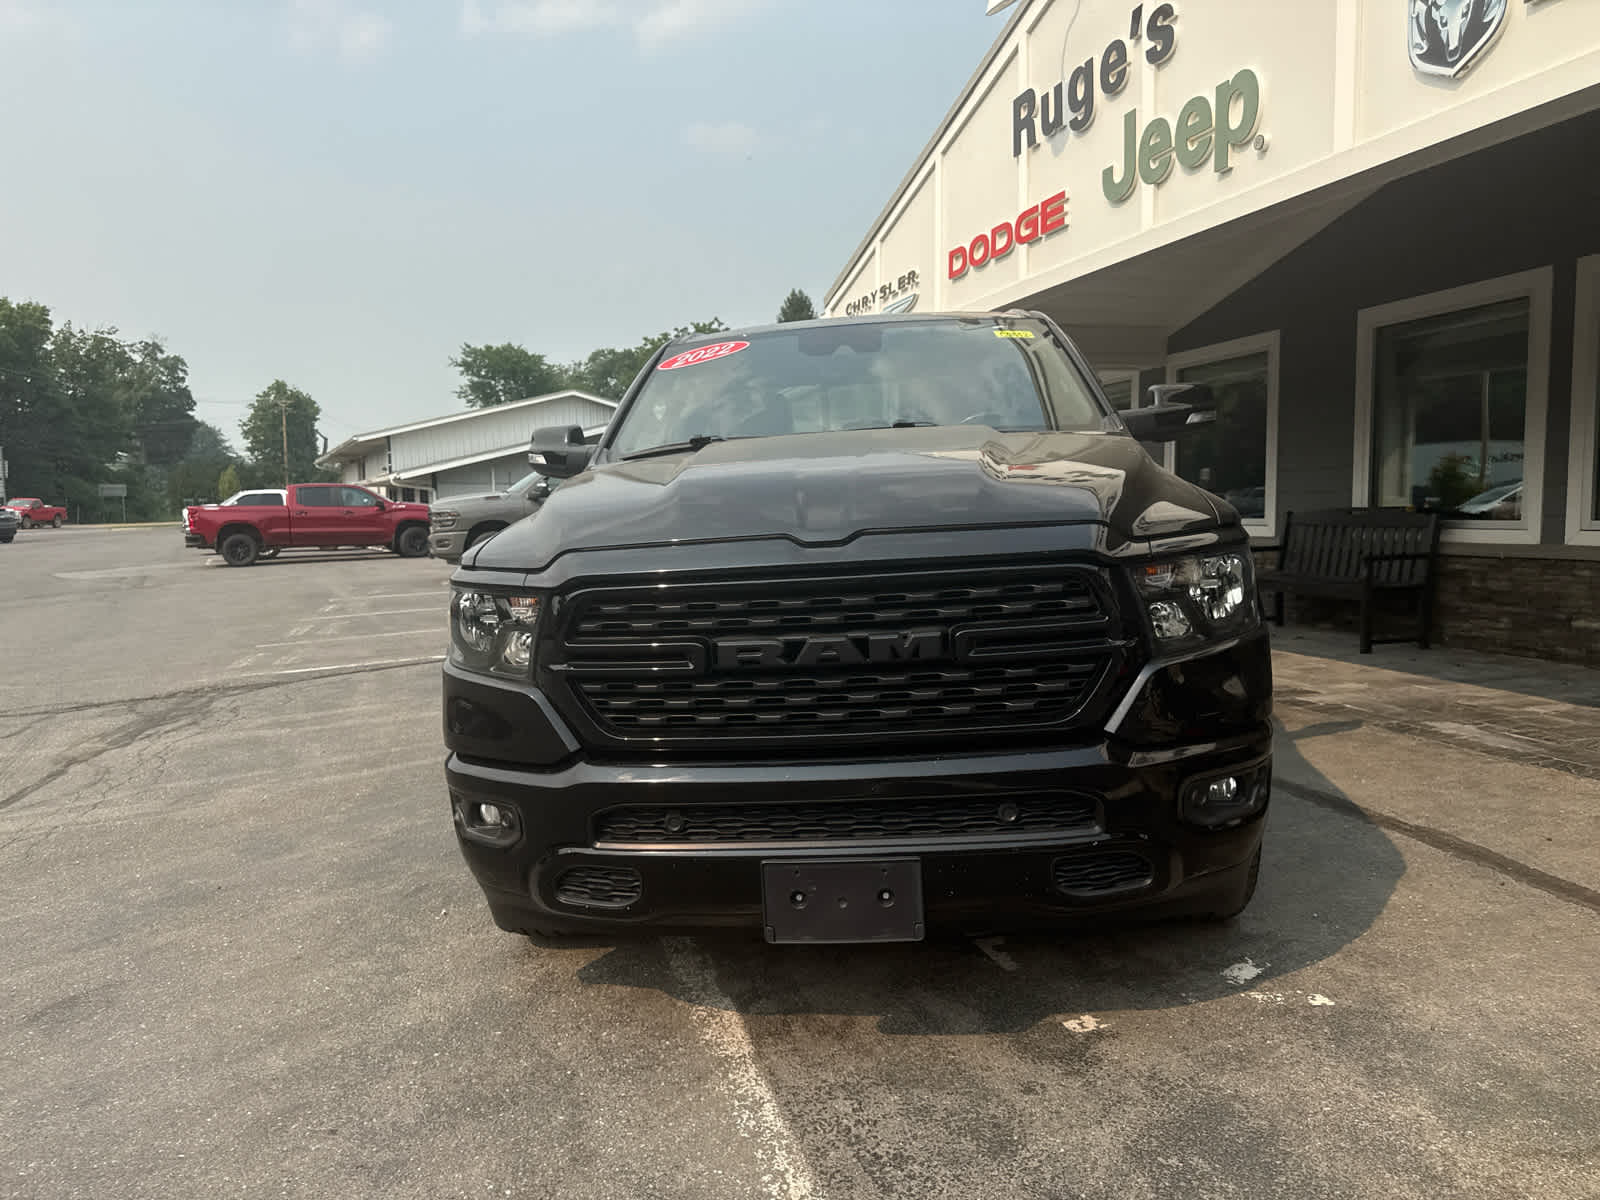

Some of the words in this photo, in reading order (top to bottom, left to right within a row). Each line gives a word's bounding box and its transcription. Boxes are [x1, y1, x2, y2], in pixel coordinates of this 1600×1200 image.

[1013, 3, 1176, 157] Ruge's
[948, 190, 1066, 280] DODGE
[846, 270, 917, 316] CHRYSLER
[672, 343, 735, 368] 2022
[714, 631, 945, 667] RAM
